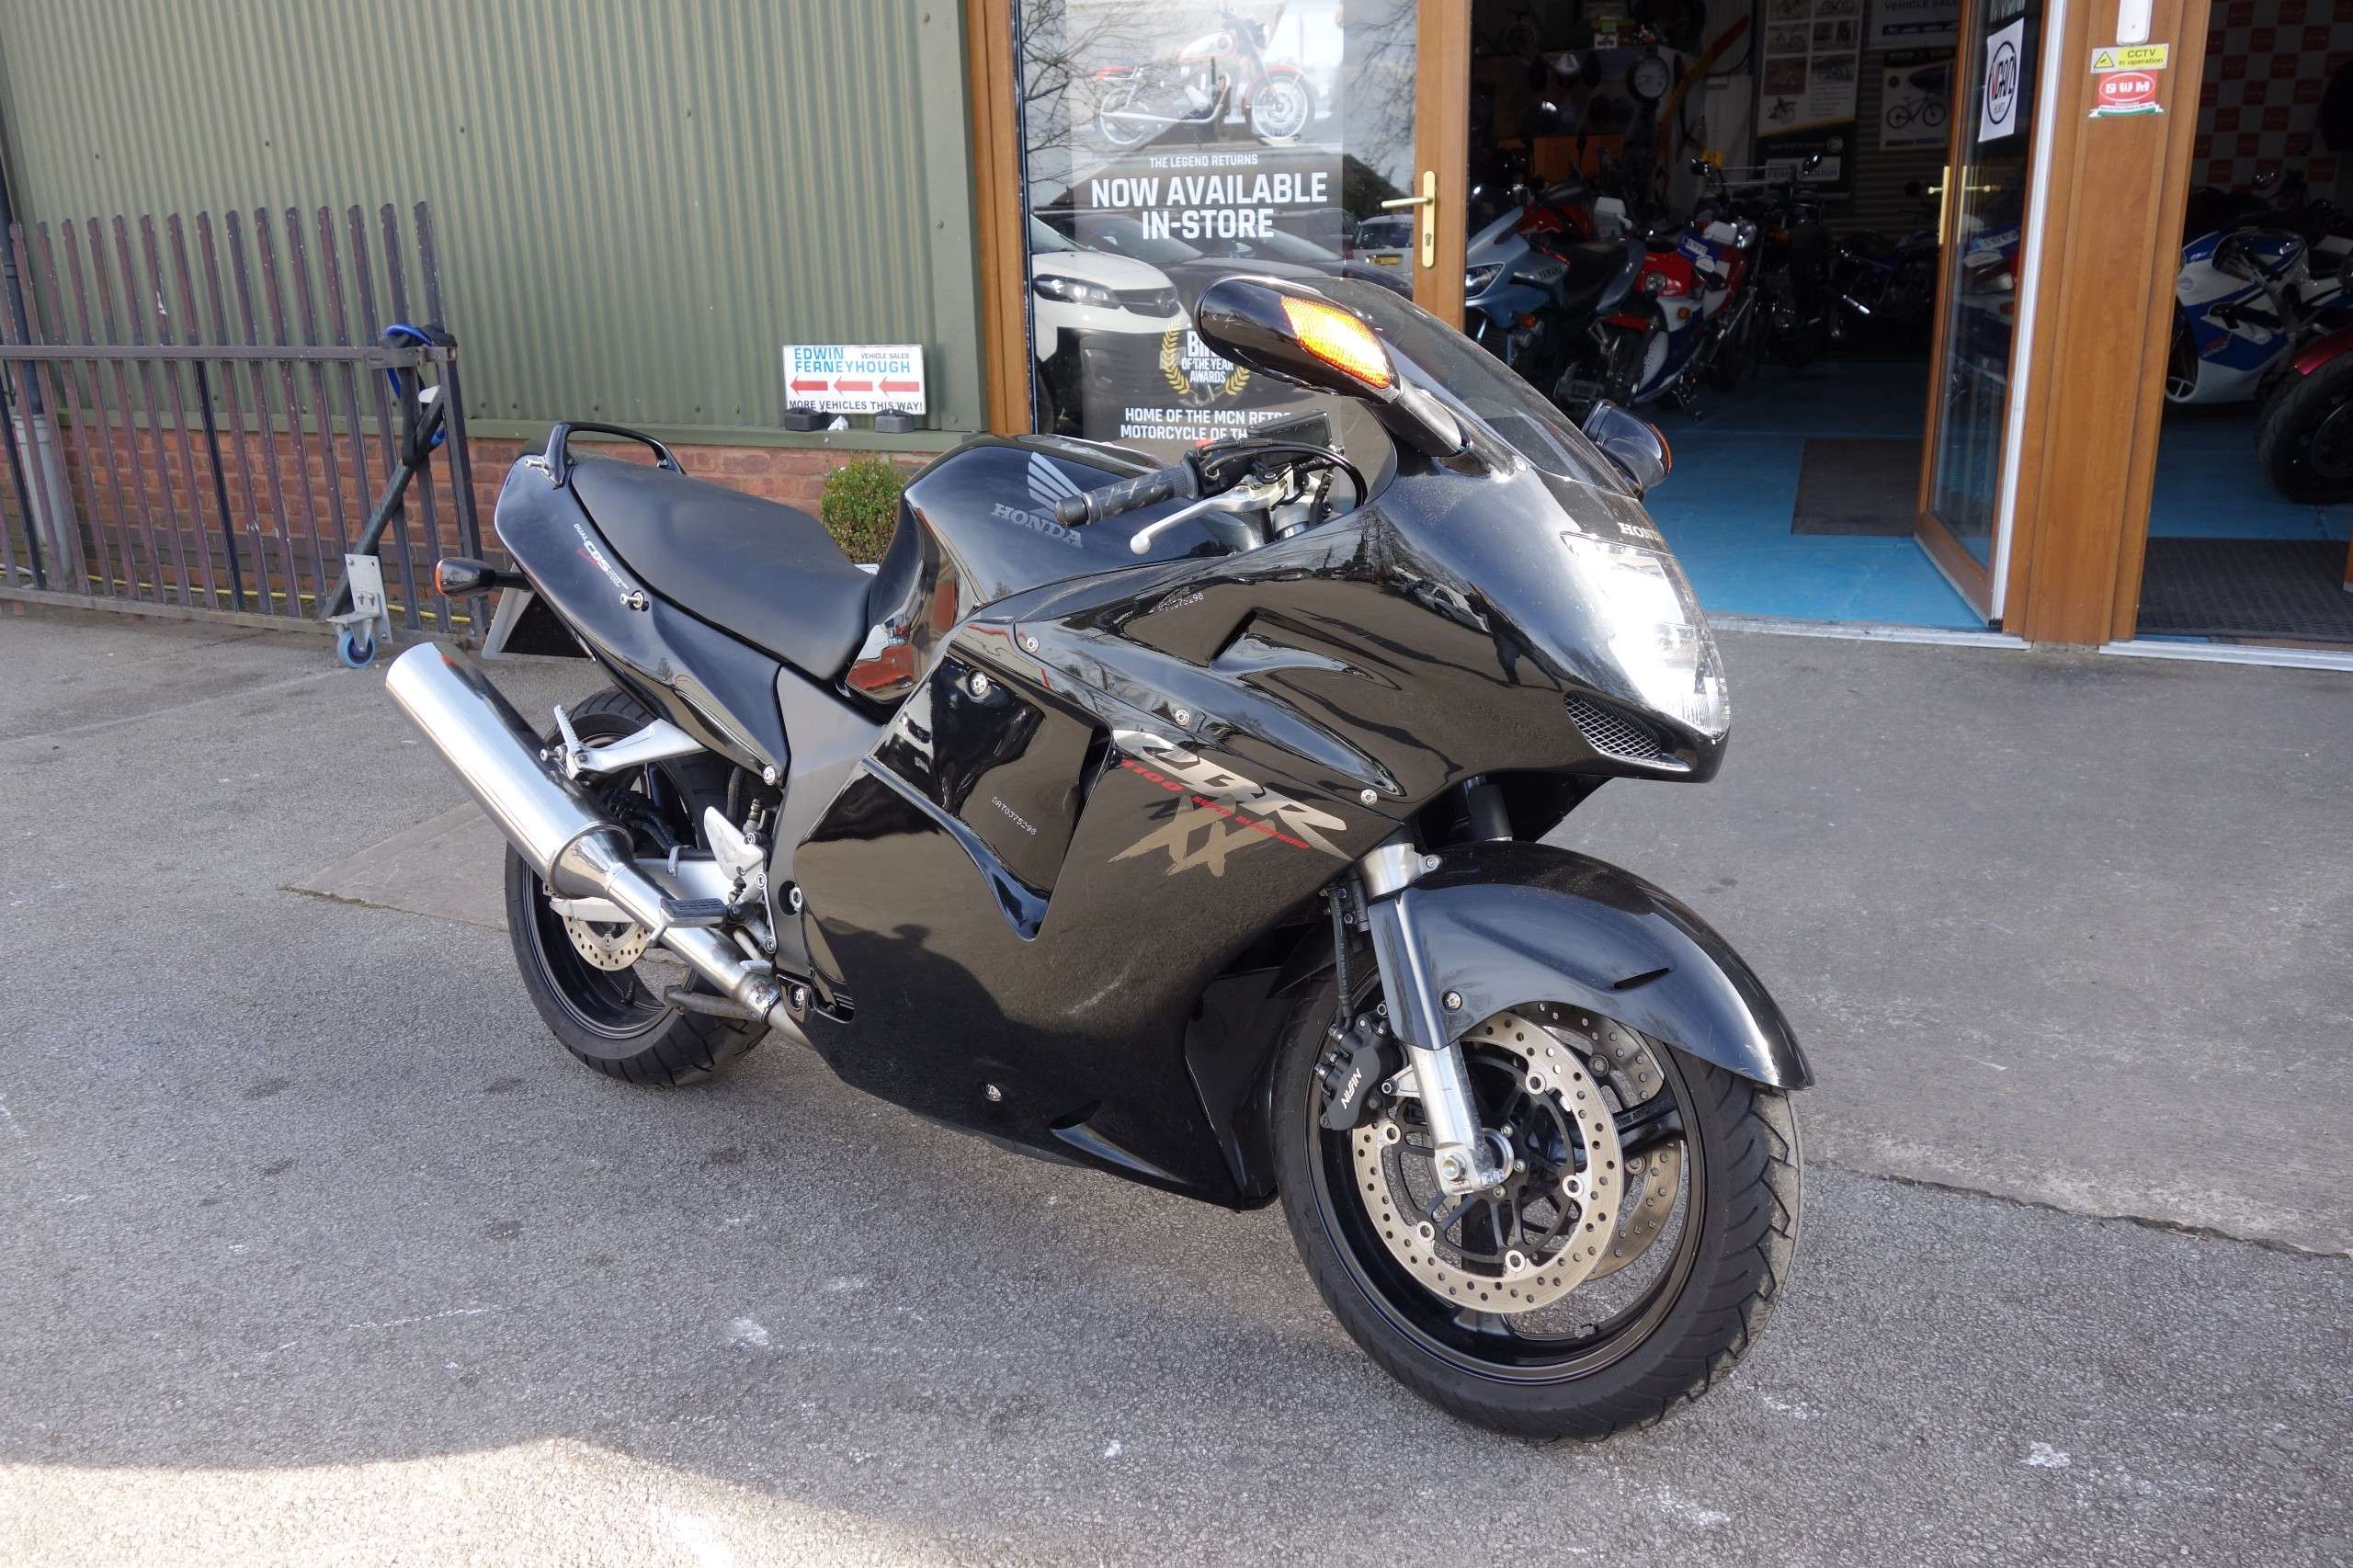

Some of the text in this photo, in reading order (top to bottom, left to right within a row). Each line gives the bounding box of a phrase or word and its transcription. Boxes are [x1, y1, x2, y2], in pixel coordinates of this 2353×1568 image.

[2128, 49, 2156, 58] CCTV
[2128, 58, 2163, 66] operation
[2105, 81, 2150, 94] SWM
[1149, 154, 1258, 168] THE LEGEND RETURNS
[1091, 172, 1328, 209] NOW AVAILABLE
[1142, 209, 1274, 240] IN-STORE
[794, 347, 844, 359] EDWIN
[795, 360, 911, 373] FERNEYHOUGH
[1181, 358, 1234, 370] OF THE YEAR
[1189, 370, 1226, 383] AWARDS
[789, 400, 923, 411] MORE VEHICLES THIS WAY!
[1125, 407, 1163, 422] HOME
[1166, 409, 1183, 423] OF
[1185, 409, 1211, 424] THE
[1214, 410, 1245, 425] MCN
[1120, 425, 1248, 440] MOTORCYCLE OF TH
[574, 523, 588, 542] DUAL
[991, 503, 1083, 550] HONDA
[1120, 759, 1185, 792] 1100
[1112, 729, 1353, 862] CBR
[1340, 1067, 1362, 1109] NISSIN
